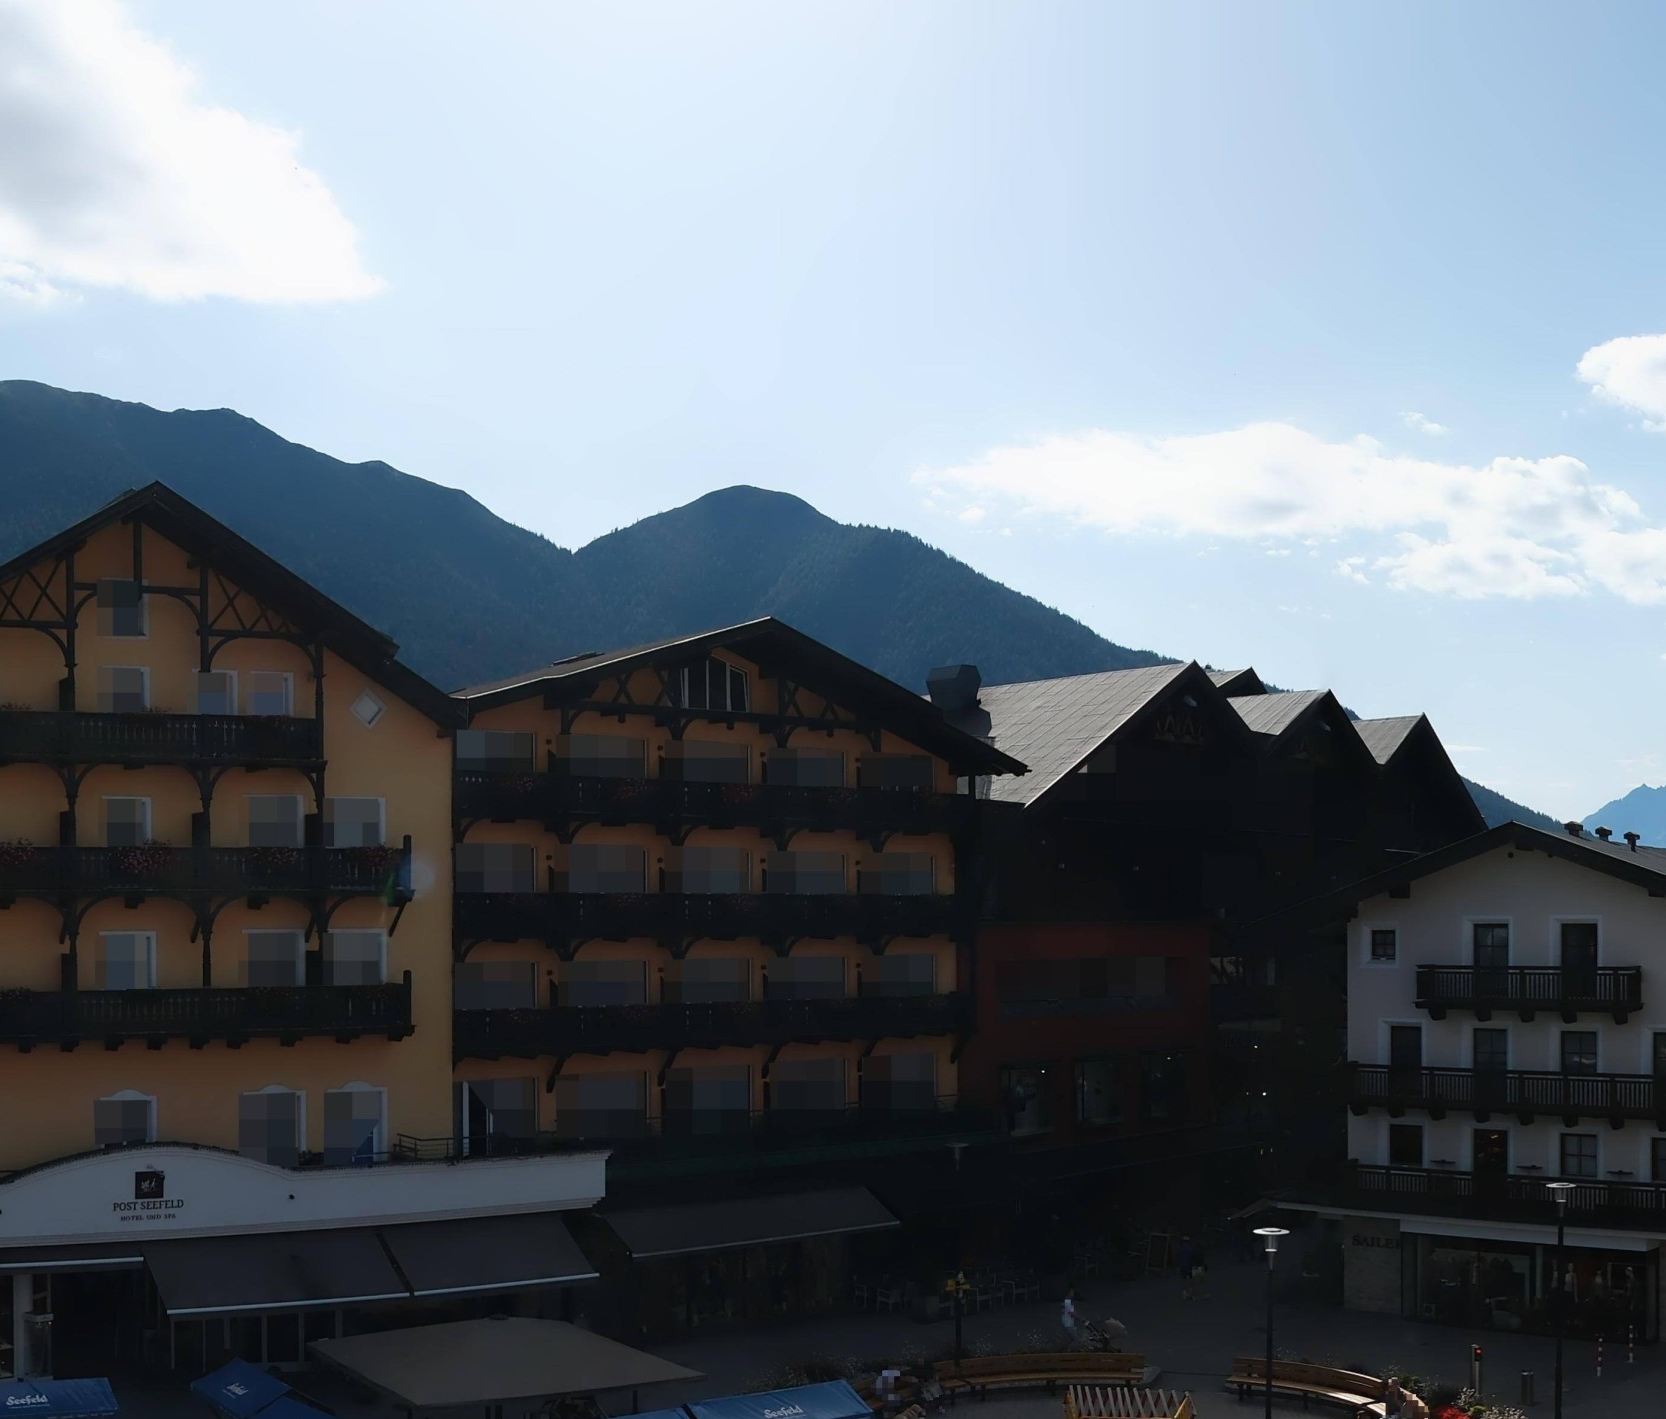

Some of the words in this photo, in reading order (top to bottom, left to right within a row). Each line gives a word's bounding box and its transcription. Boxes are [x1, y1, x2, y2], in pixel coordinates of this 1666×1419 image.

[113, 1201, 138, 1211] POST
[140, 1199, 184, 1209] SEEFELD
[6, 1395, 48, 1407] Seefeld
[765, 1404, 803, 1419] Seefeld
